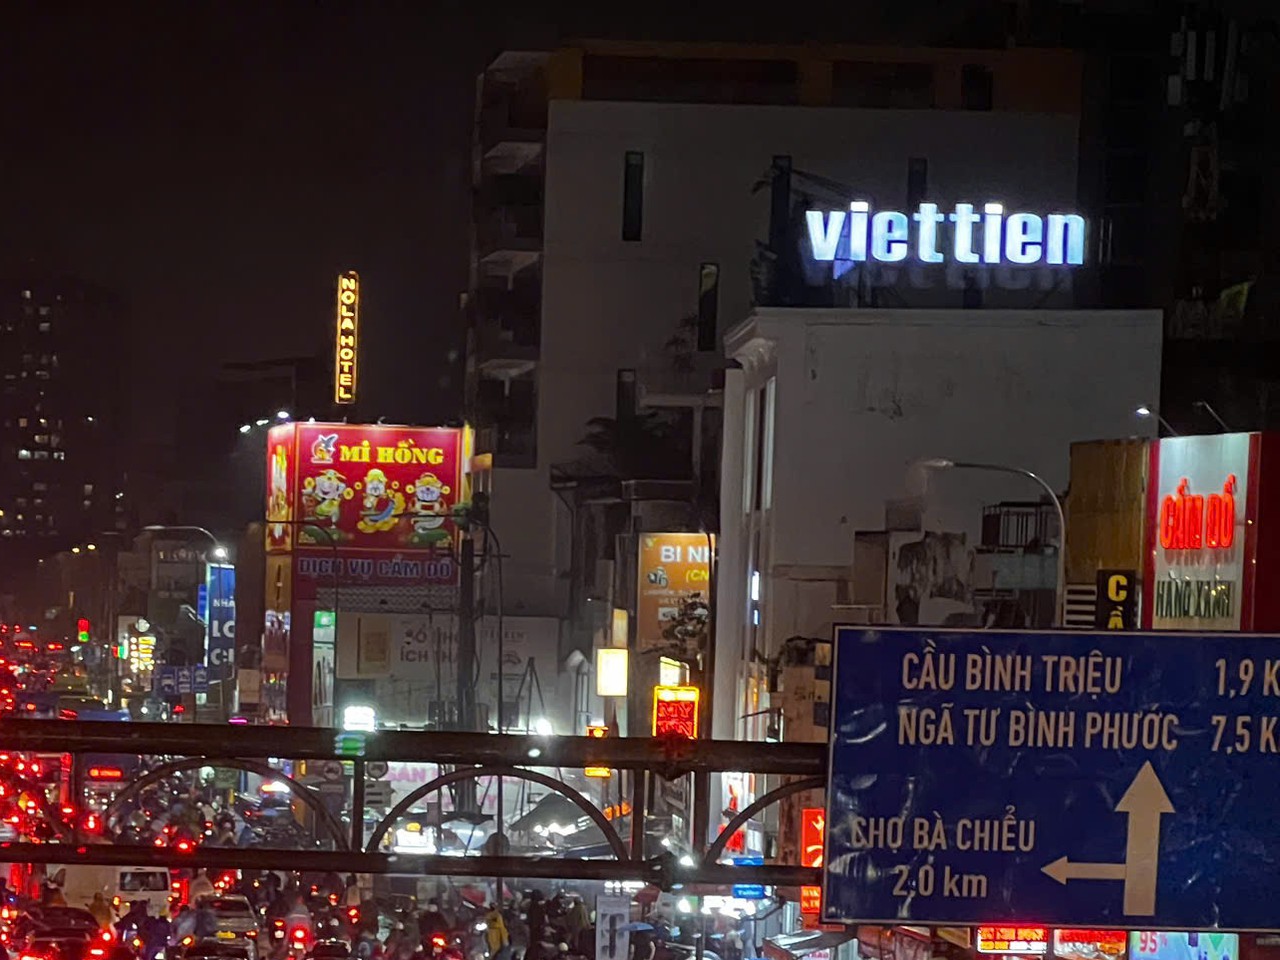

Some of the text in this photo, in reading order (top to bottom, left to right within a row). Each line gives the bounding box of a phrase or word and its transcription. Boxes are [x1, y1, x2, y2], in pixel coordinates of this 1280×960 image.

[805, 201, 1085, 264] viettien
[339, 277, 356, 399] NOLA HOTEL
[376, 438, 444, 465] HỒNG
[661, 545, 681, 563] BI
[901, 639, 956, 691] CẦU
[965, 645, 1032, 692] BÌNH
[1042, 649, 1122, 700] TRIỆU
[1215, 658, 1254, 698] 1,9
[898, 702, 954, 746] NGÃ
[963, 707, 1001, 747] TƯ
[1008, 701, 1075, 748] BÌNH
[1084, 702, 1179, 751] PHƯỚC
[1211, 715, 1252, 755] 7,5
[851, 805, 1035, 853] CHỢ BÀ CHIỂU
[892, 864, 987, 899] 2,0 km
